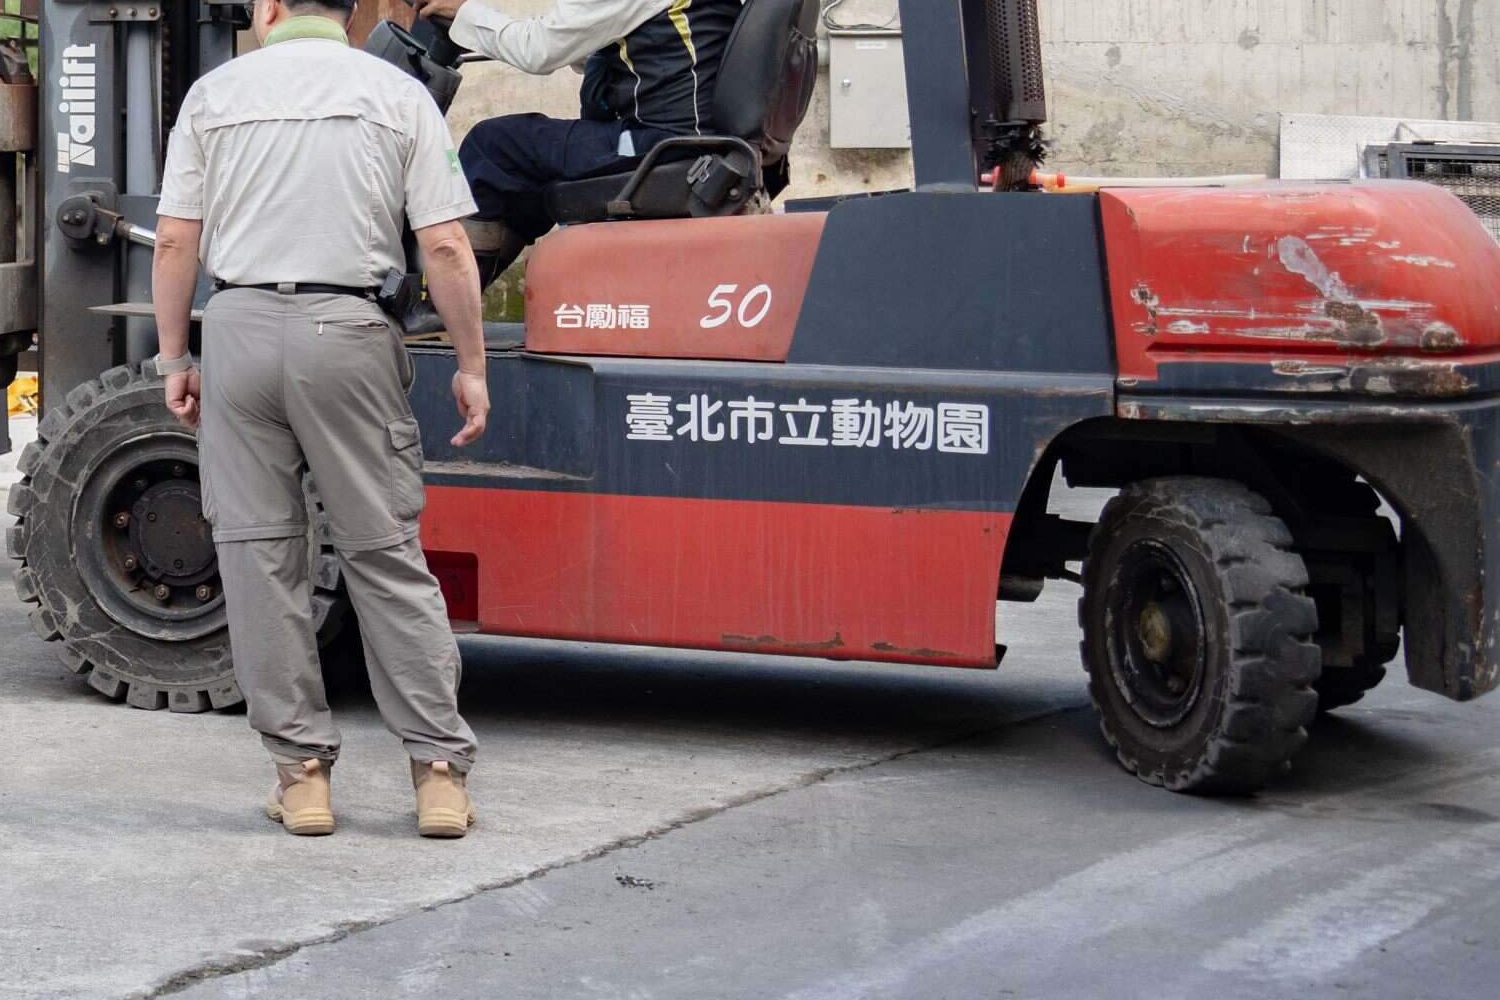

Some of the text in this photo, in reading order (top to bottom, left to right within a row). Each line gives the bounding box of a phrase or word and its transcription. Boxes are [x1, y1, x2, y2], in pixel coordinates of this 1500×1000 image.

[57, 43, 96, 174] Tailift
[553, 303, 651, 329] 台勵福
[700, 283, 772, 329] 50
[626, 392, 989, 454] 臺北市立動物園
